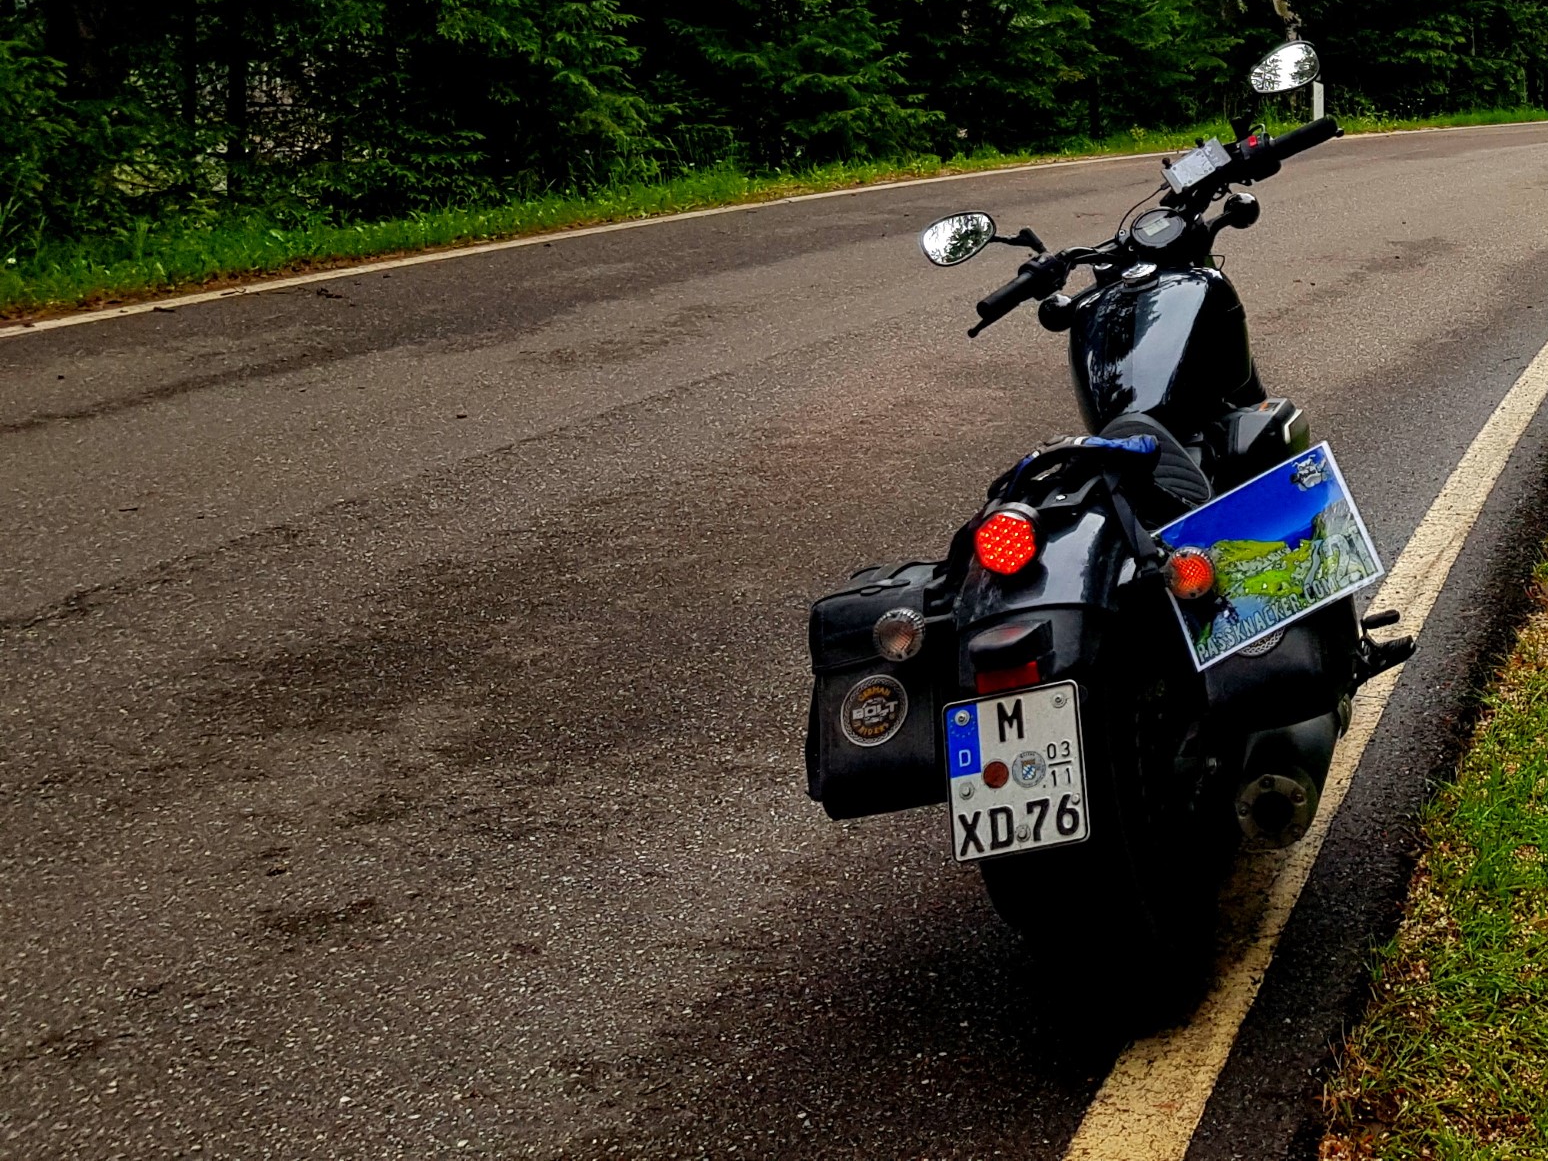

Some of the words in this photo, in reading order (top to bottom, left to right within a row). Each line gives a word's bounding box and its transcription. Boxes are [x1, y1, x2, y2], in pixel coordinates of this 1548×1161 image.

[1197, 576, 1338, 663] PASSKNACKER.COM
[852, 701, 898, 719] BOLT
[997, 698, 1025, 743] M
[958, 749, 972, 767] D
[1046, 741, 1071, 759] 03
[1050, 767, 1072, 787] 11
